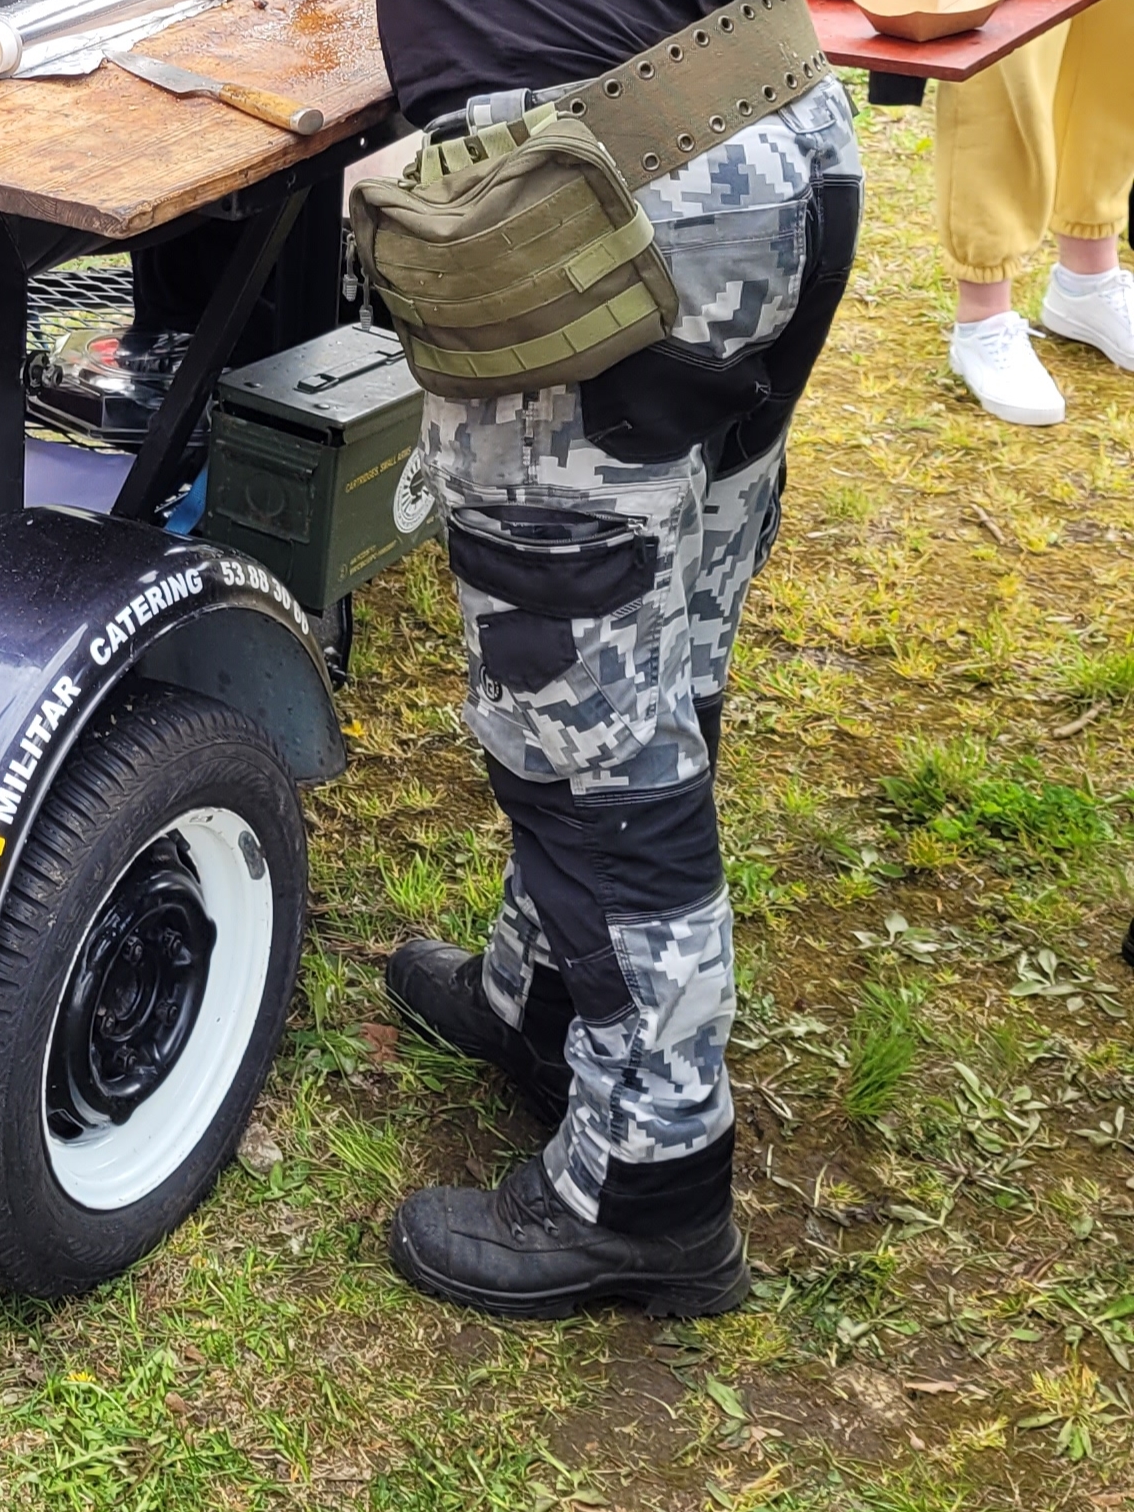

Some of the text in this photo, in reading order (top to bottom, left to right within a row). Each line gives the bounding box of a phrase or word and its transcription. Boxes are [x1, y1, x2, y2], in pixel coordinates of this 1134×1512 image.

[89, 568, 204, 666] CATERING
[219, 561, 246, 586] 53
[247, 564, 270, 593] 88
[271, 576, 293, 610] 30
